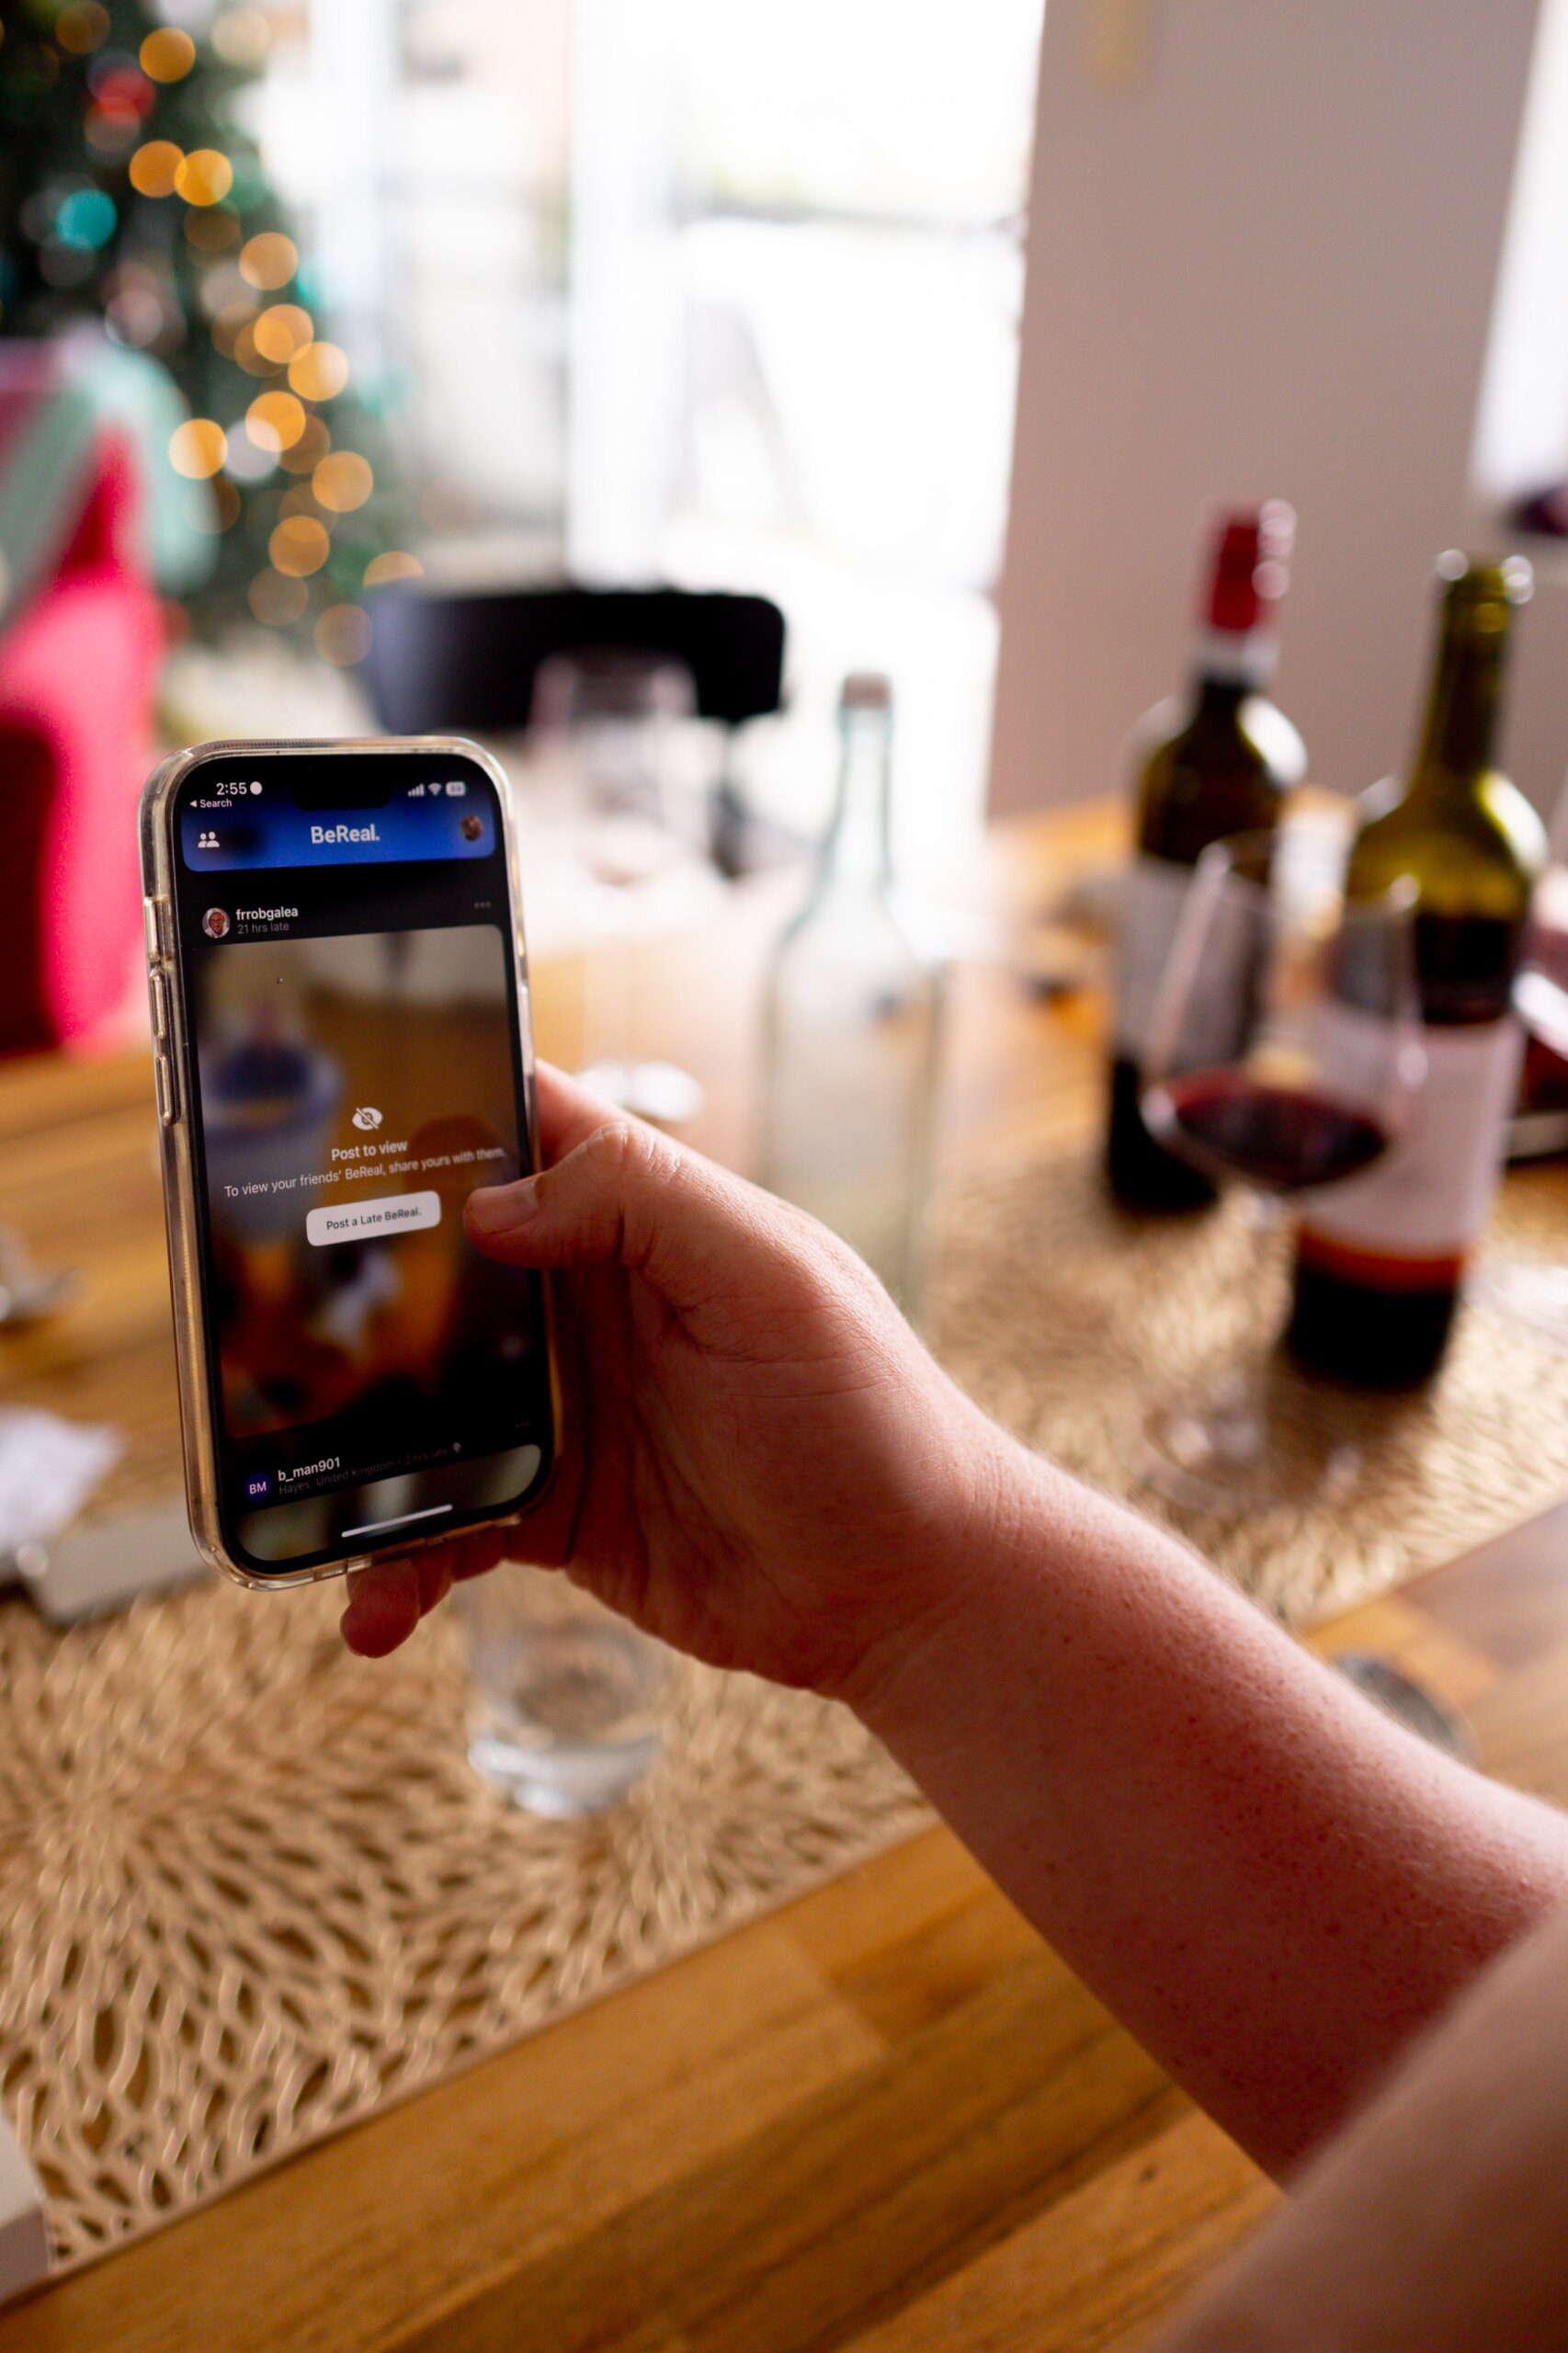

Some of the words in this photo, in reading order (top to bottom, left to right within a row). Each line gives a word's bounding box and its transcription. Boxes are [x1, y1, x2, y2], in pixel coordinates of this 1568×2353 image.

[216, 782, 247, 795] 2:55
[199, 798, 232, 809] Search
[311, 824, 381, 844] BeReal.
[235, 906, 299, 921] frrobgalea
[237, 925, 250, 935] 21
[252, 923, 268, 934] hrs
[270, 921, 290, 933] late
[331, 1145, 360, 1161] Post
[363, 1144, 377, 1156] to
[379, 1140, 408, 1153] view
[224, 1185, 239, 1197] To
[242, 1182, 268, 1195] view
[271, 1178, 297, 1193] your
[345, 1163, 386, 1180] BeReal,
[389, 1160, 419, 1174] share
[421, 1154, 451, 1171] yours
[452, 1149, 474, 1164] with
[476, 1146, 506, 1161] them.
[326, 1218, 349, 1230] Post
[352, 1219, 358, 1227] a
[360, 1213, 382, 1225] Late
[384, 1206, 422, 1221] BeReal.
[278, 1457, 341, 1483] b_man901
[278, 1480, 313, 1495] Hayes,
[315, 1471, 349, 1486] United
[351, 1460, 395, 1478] Kingdom
[249, 1481, 267, 1495] BM
